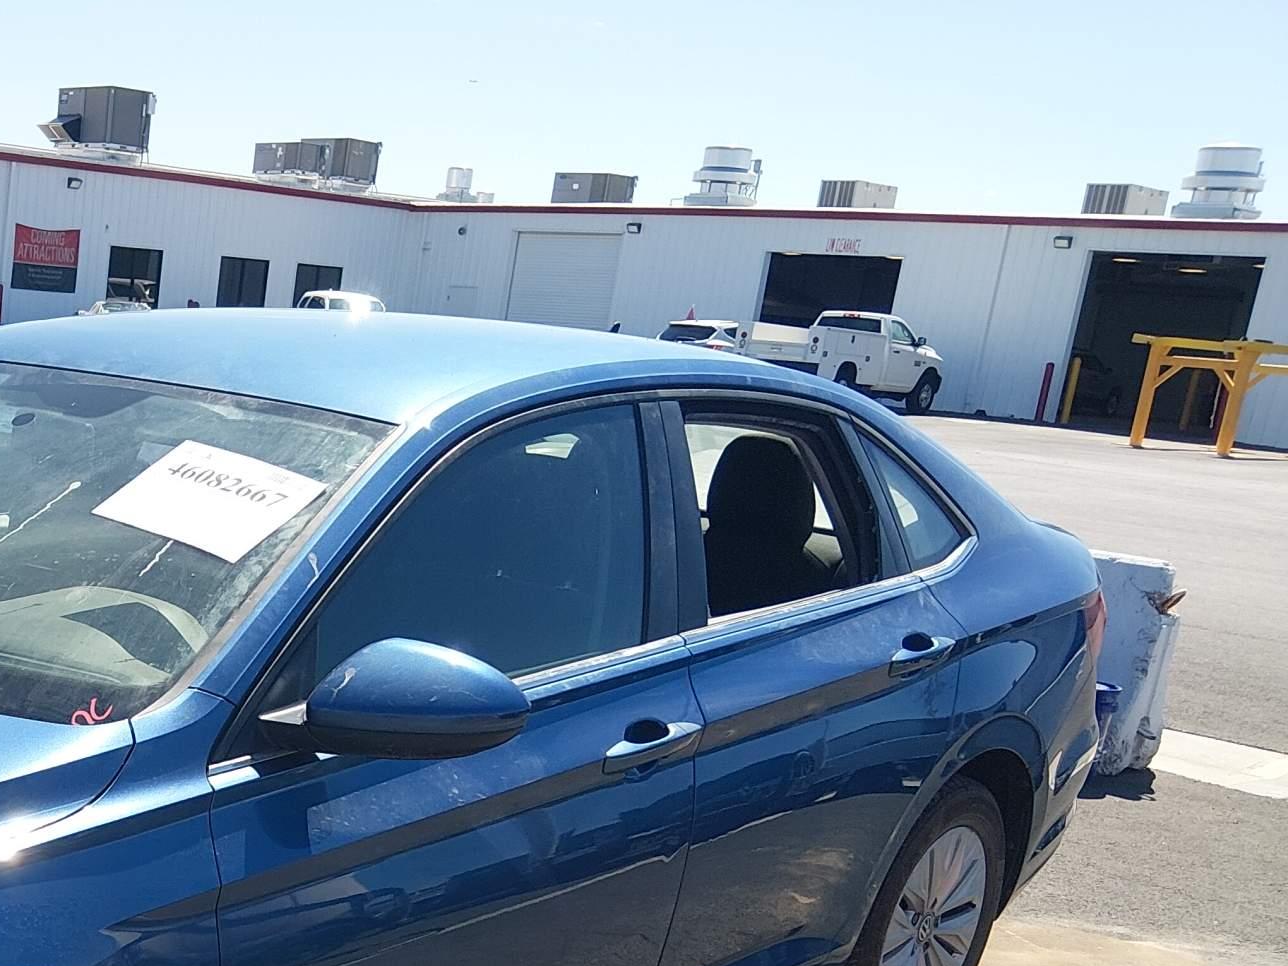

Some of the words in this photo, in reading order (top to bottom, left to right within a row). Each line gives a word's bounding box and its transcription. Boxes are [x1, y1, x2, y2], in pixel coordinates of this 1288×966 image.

[31, 229, 66, 246] COMING
[16, 242, 76, 263] ATTRACTIONS
[168, 462, 289, 506] 46082667
